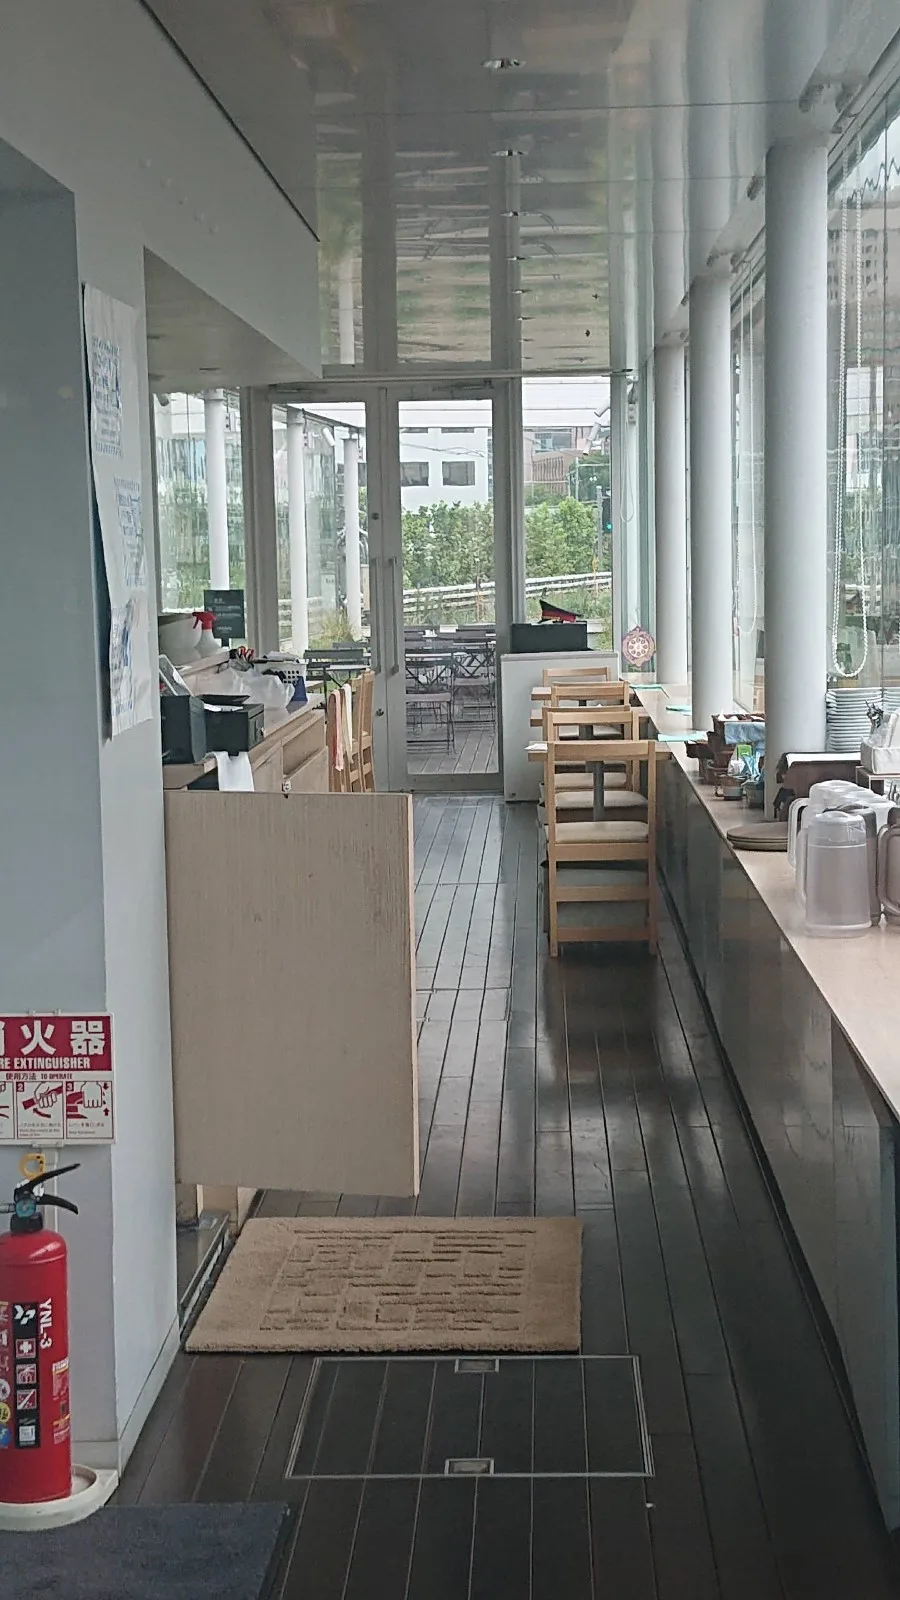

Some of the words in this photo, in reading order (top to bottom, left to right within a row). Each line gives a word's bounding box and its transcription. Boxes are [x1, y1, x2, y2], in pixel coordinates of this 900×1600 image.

[0, 1020, 105, 1055] 火器
[14, 1057, 91, 1069] EXTINGUISHER
[6, 1072, 37, 1081] 使用方法
[18, 1083, 24, 1091] 2
[67, 1083, 73, 1091] 3
[39, 1297, 53, 1349] YNL-3
